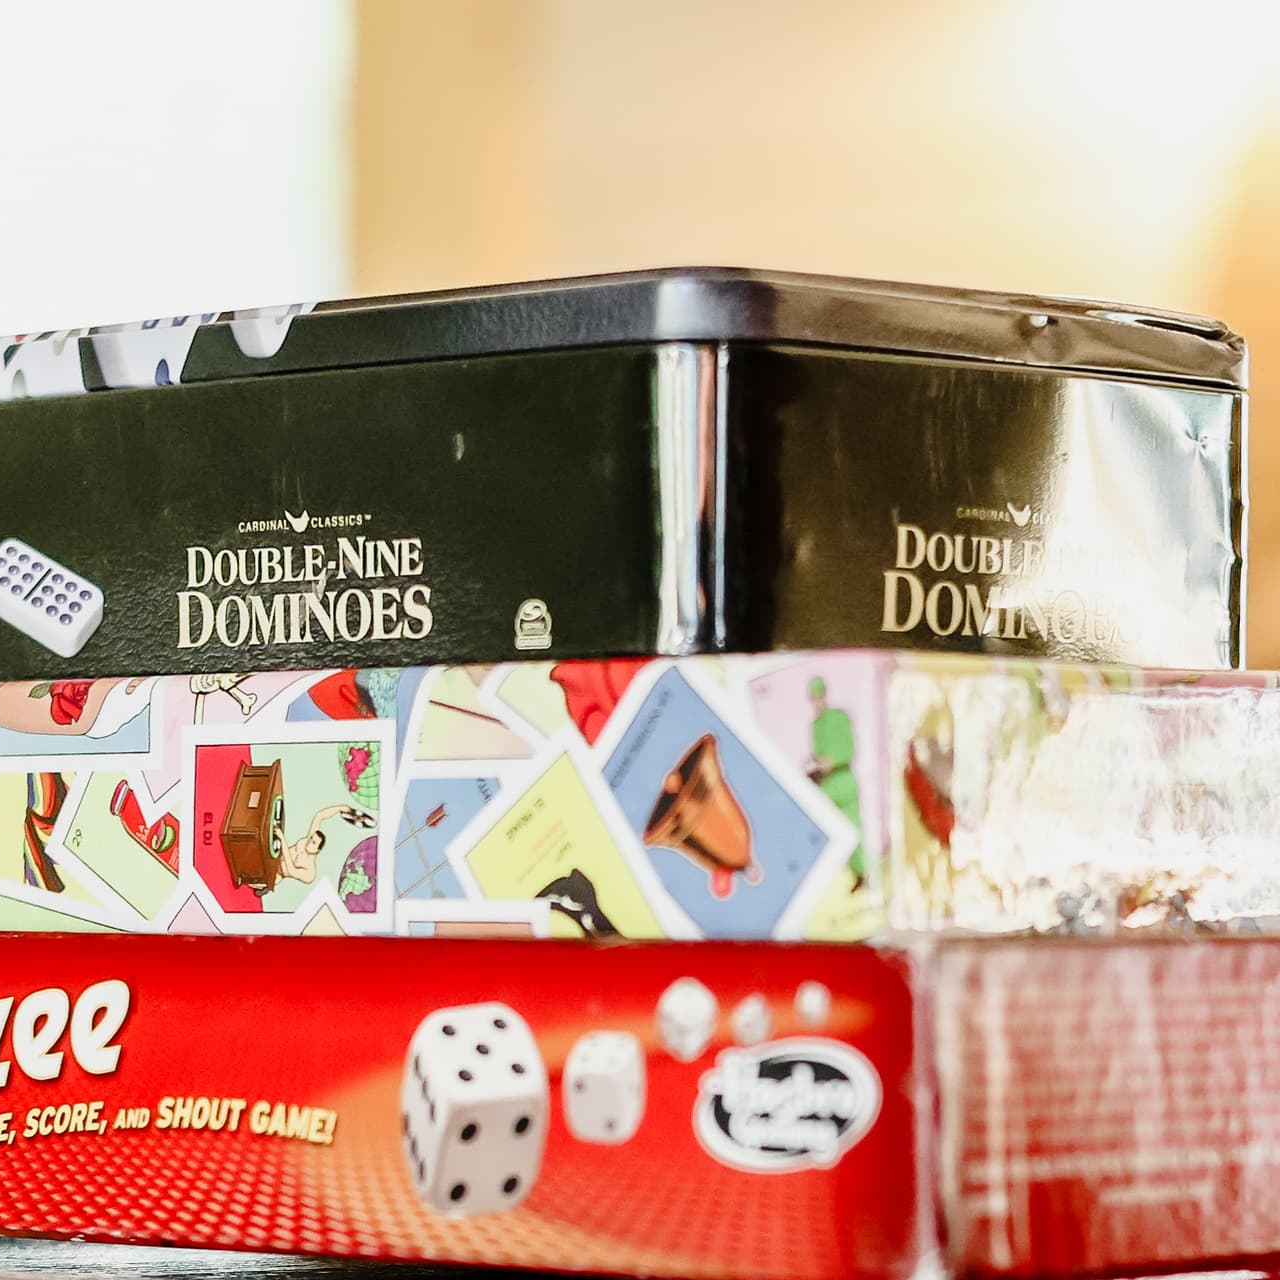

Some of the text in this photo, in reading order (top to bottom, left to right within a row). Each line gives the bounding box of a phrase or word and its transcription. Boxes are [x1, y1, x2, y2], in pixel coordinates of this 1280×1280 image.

[238, 520, 290, 533] CARDINAL
[186, 535, 424, 588] DOUBLE-NINE
[176, 585, 434, 649] DOMINOES
[22, 1101, 108, 1138] SCORE,
[113, 1108, 149, 1130] AND
[156, 1096, 247, 1132] SHOUT
[250, 1100, 338, 1144] GAME!
